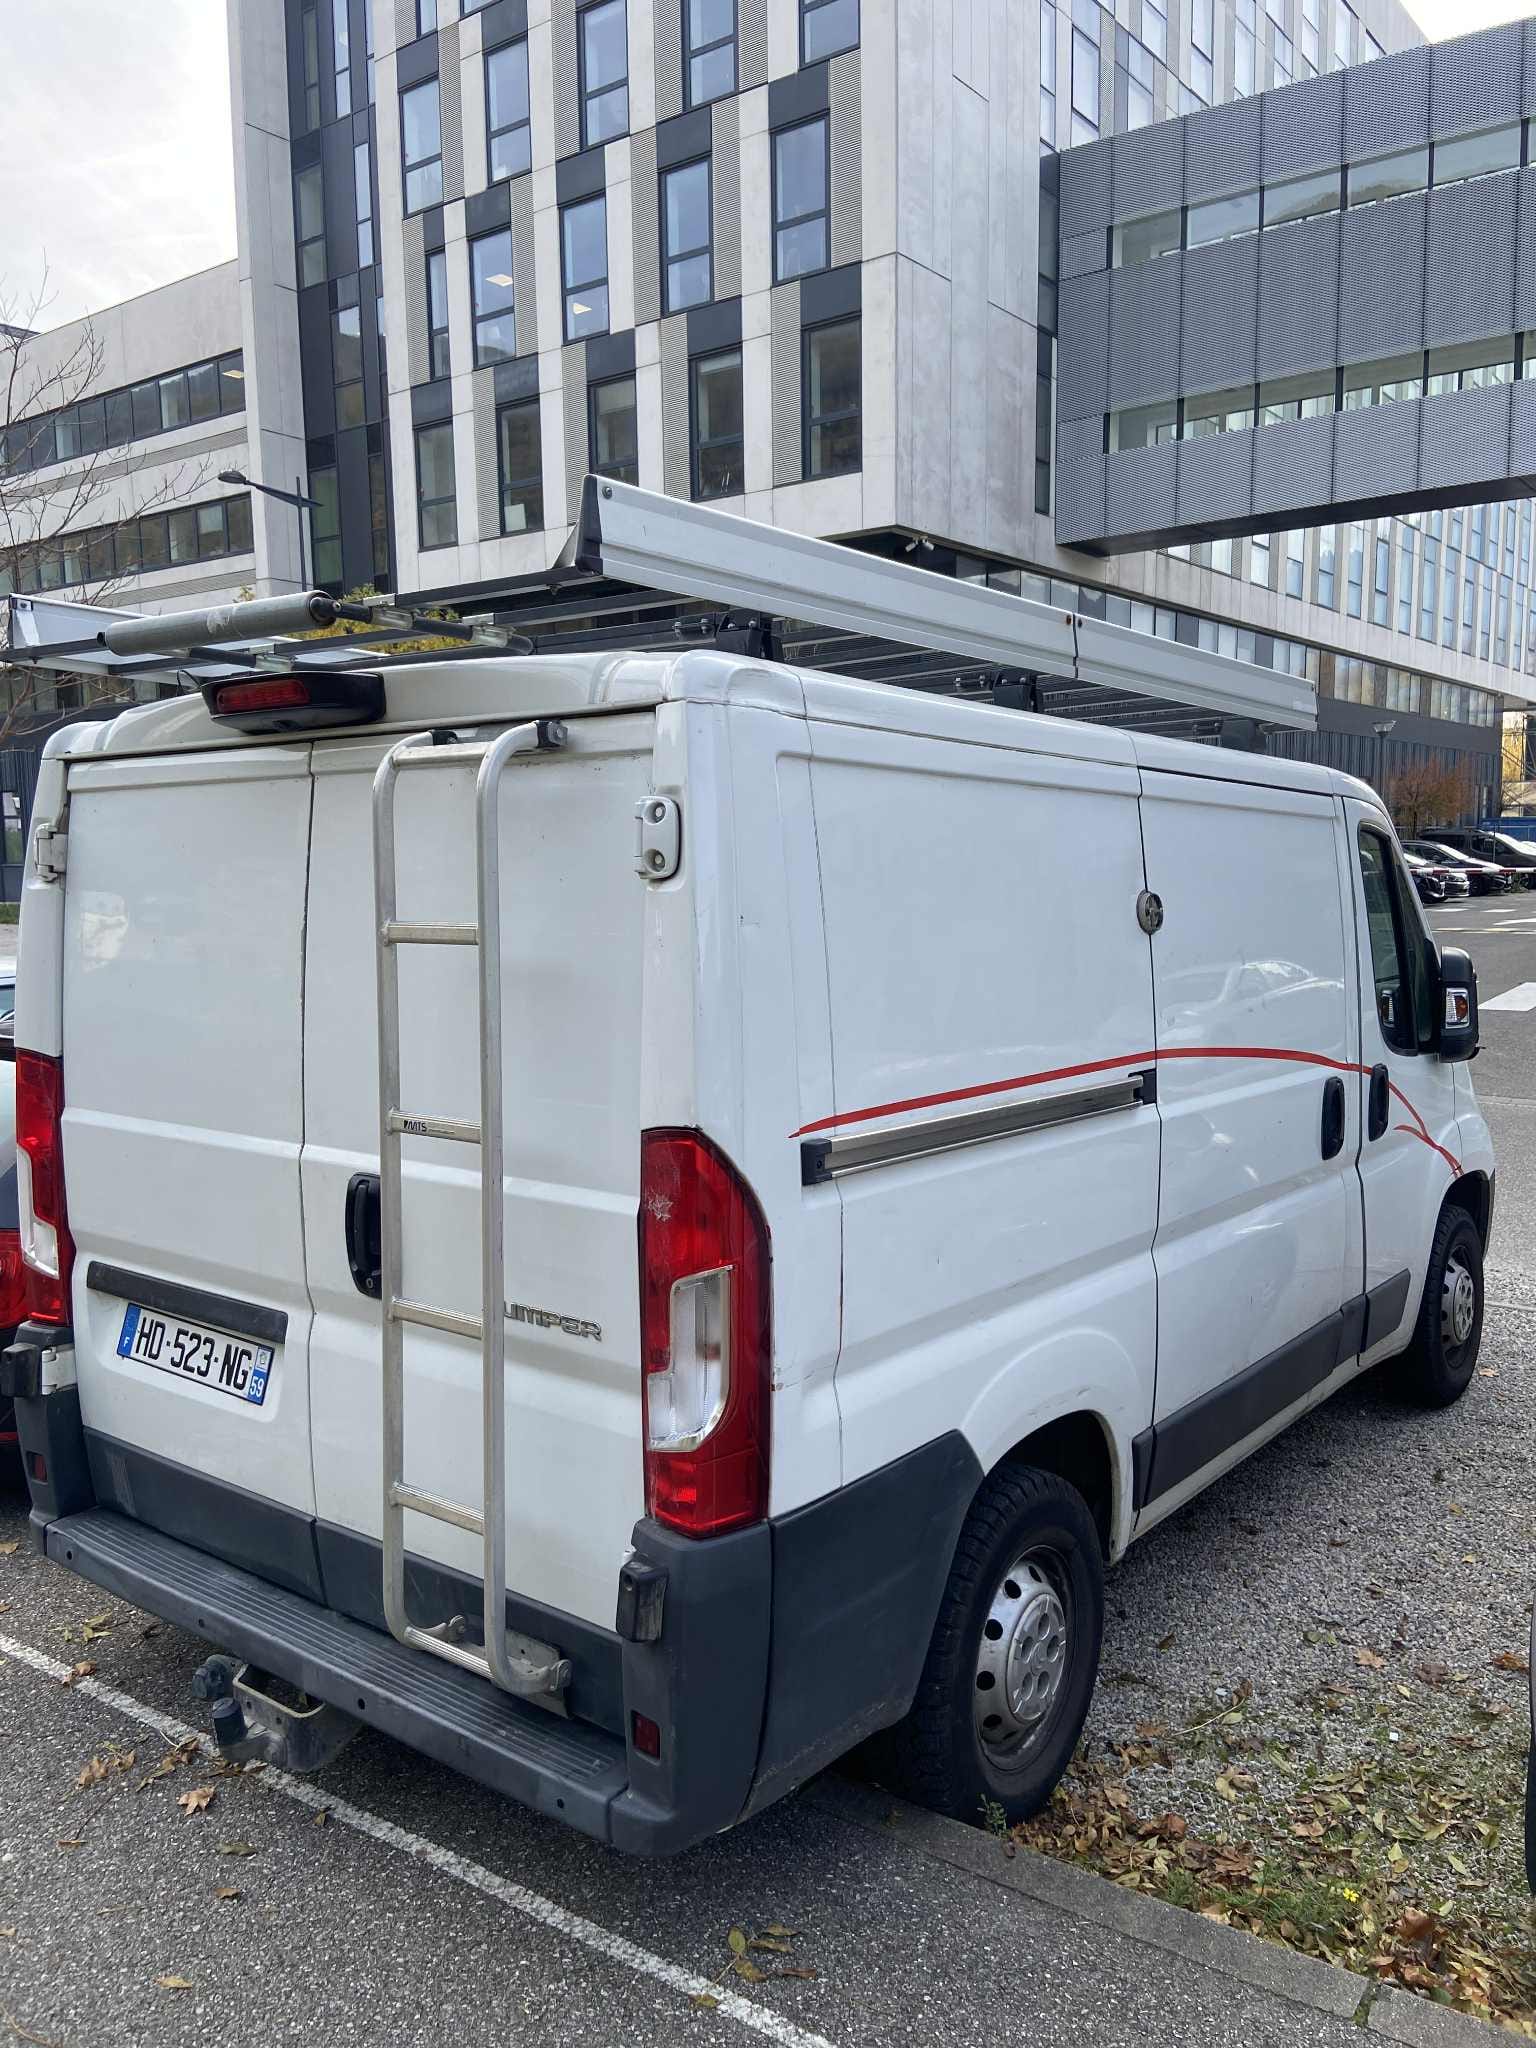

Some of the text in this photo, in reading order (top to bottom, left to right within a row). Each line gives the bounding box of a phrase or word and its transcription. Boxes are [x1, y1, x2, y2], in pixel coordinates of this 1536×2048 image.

[503, 1301, 602, 1342] UMPER
[123, 1336, 131, 1348] F
[249, 1377, 265, 1398] 59
